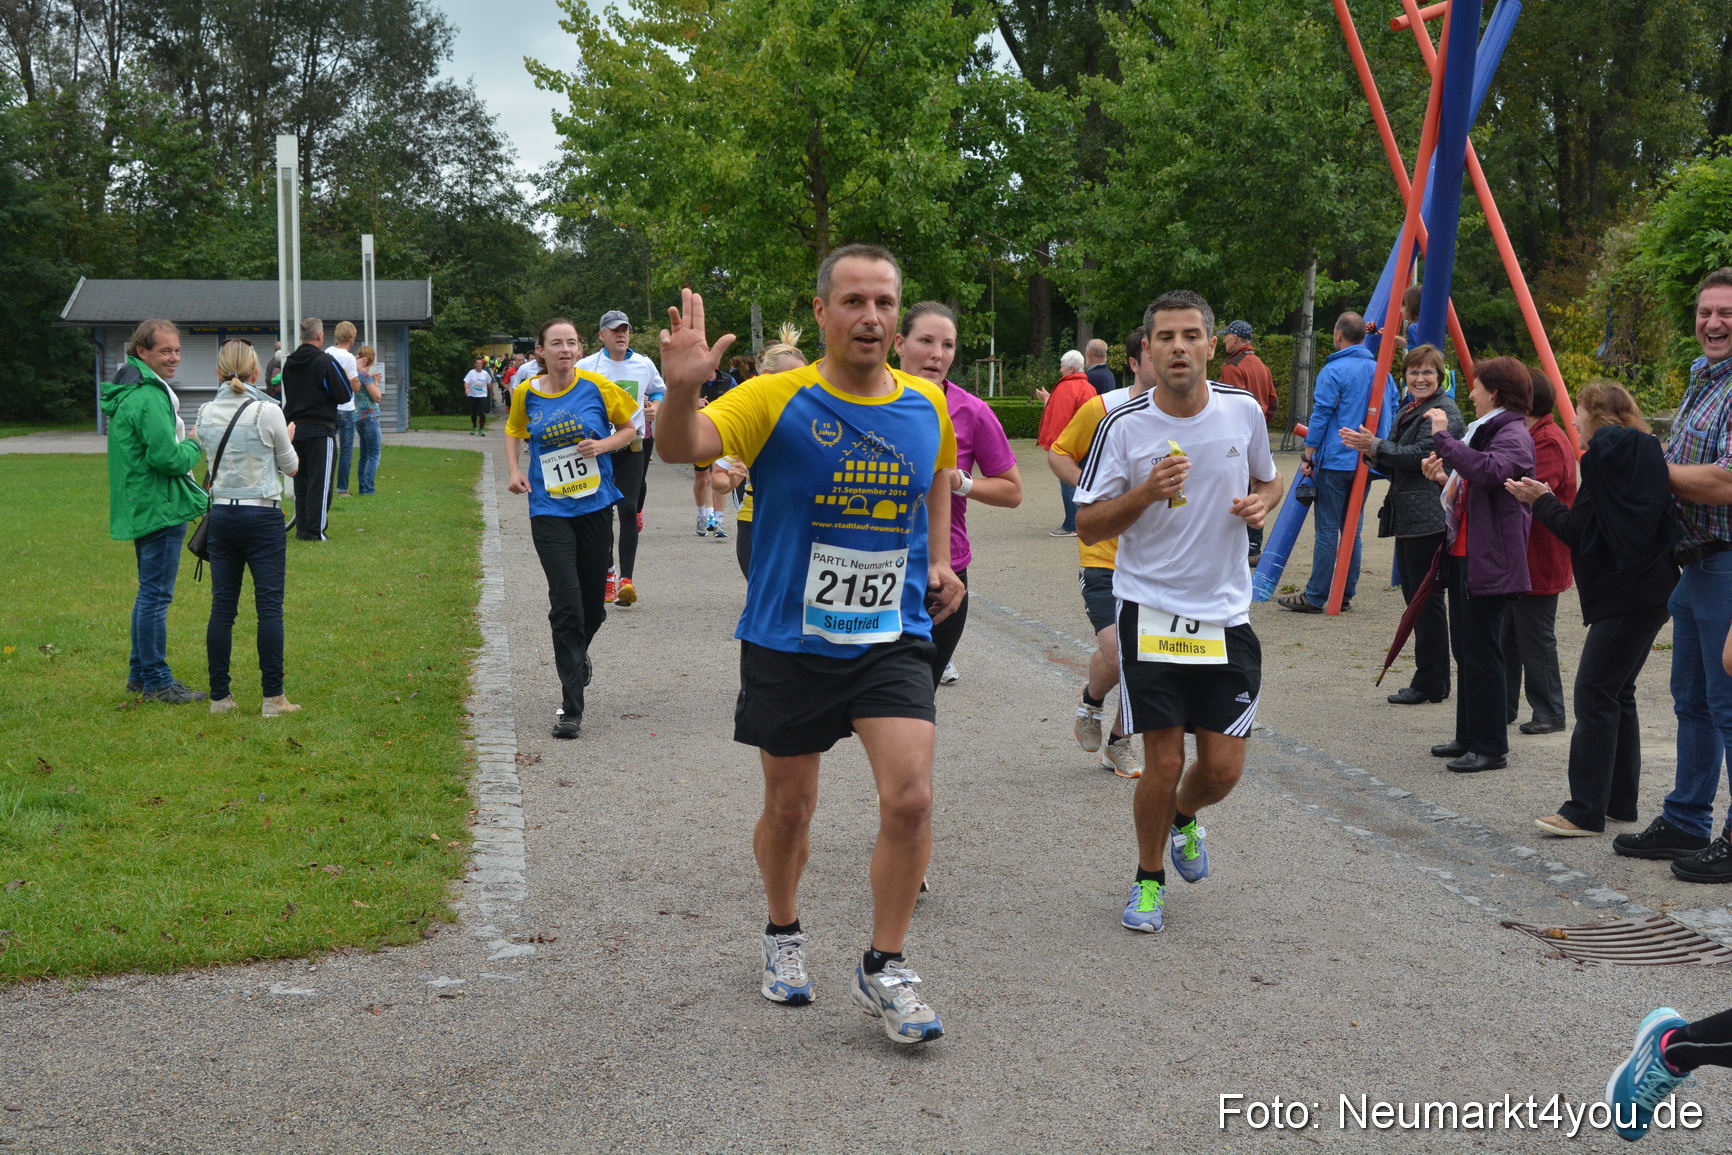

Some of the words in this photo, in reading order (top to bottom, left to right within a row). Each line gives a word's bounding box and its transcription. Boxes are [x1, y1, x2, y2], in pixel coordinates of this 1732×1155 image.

[541, 456, 558, 465] PARTL
[553, 457, 588, 482] 115
[562, 482, 588, 494] Andrea
[832, 486, 887, 496] 21.September
[813, 552, 847, 567] PARTL
[850, 560, 893, 570] Neumarkt
[815, 570, 897, 608] 2152
[824, 615, 880, 633] Siegfried
[1158, 639, 1206, 654] Matthias
